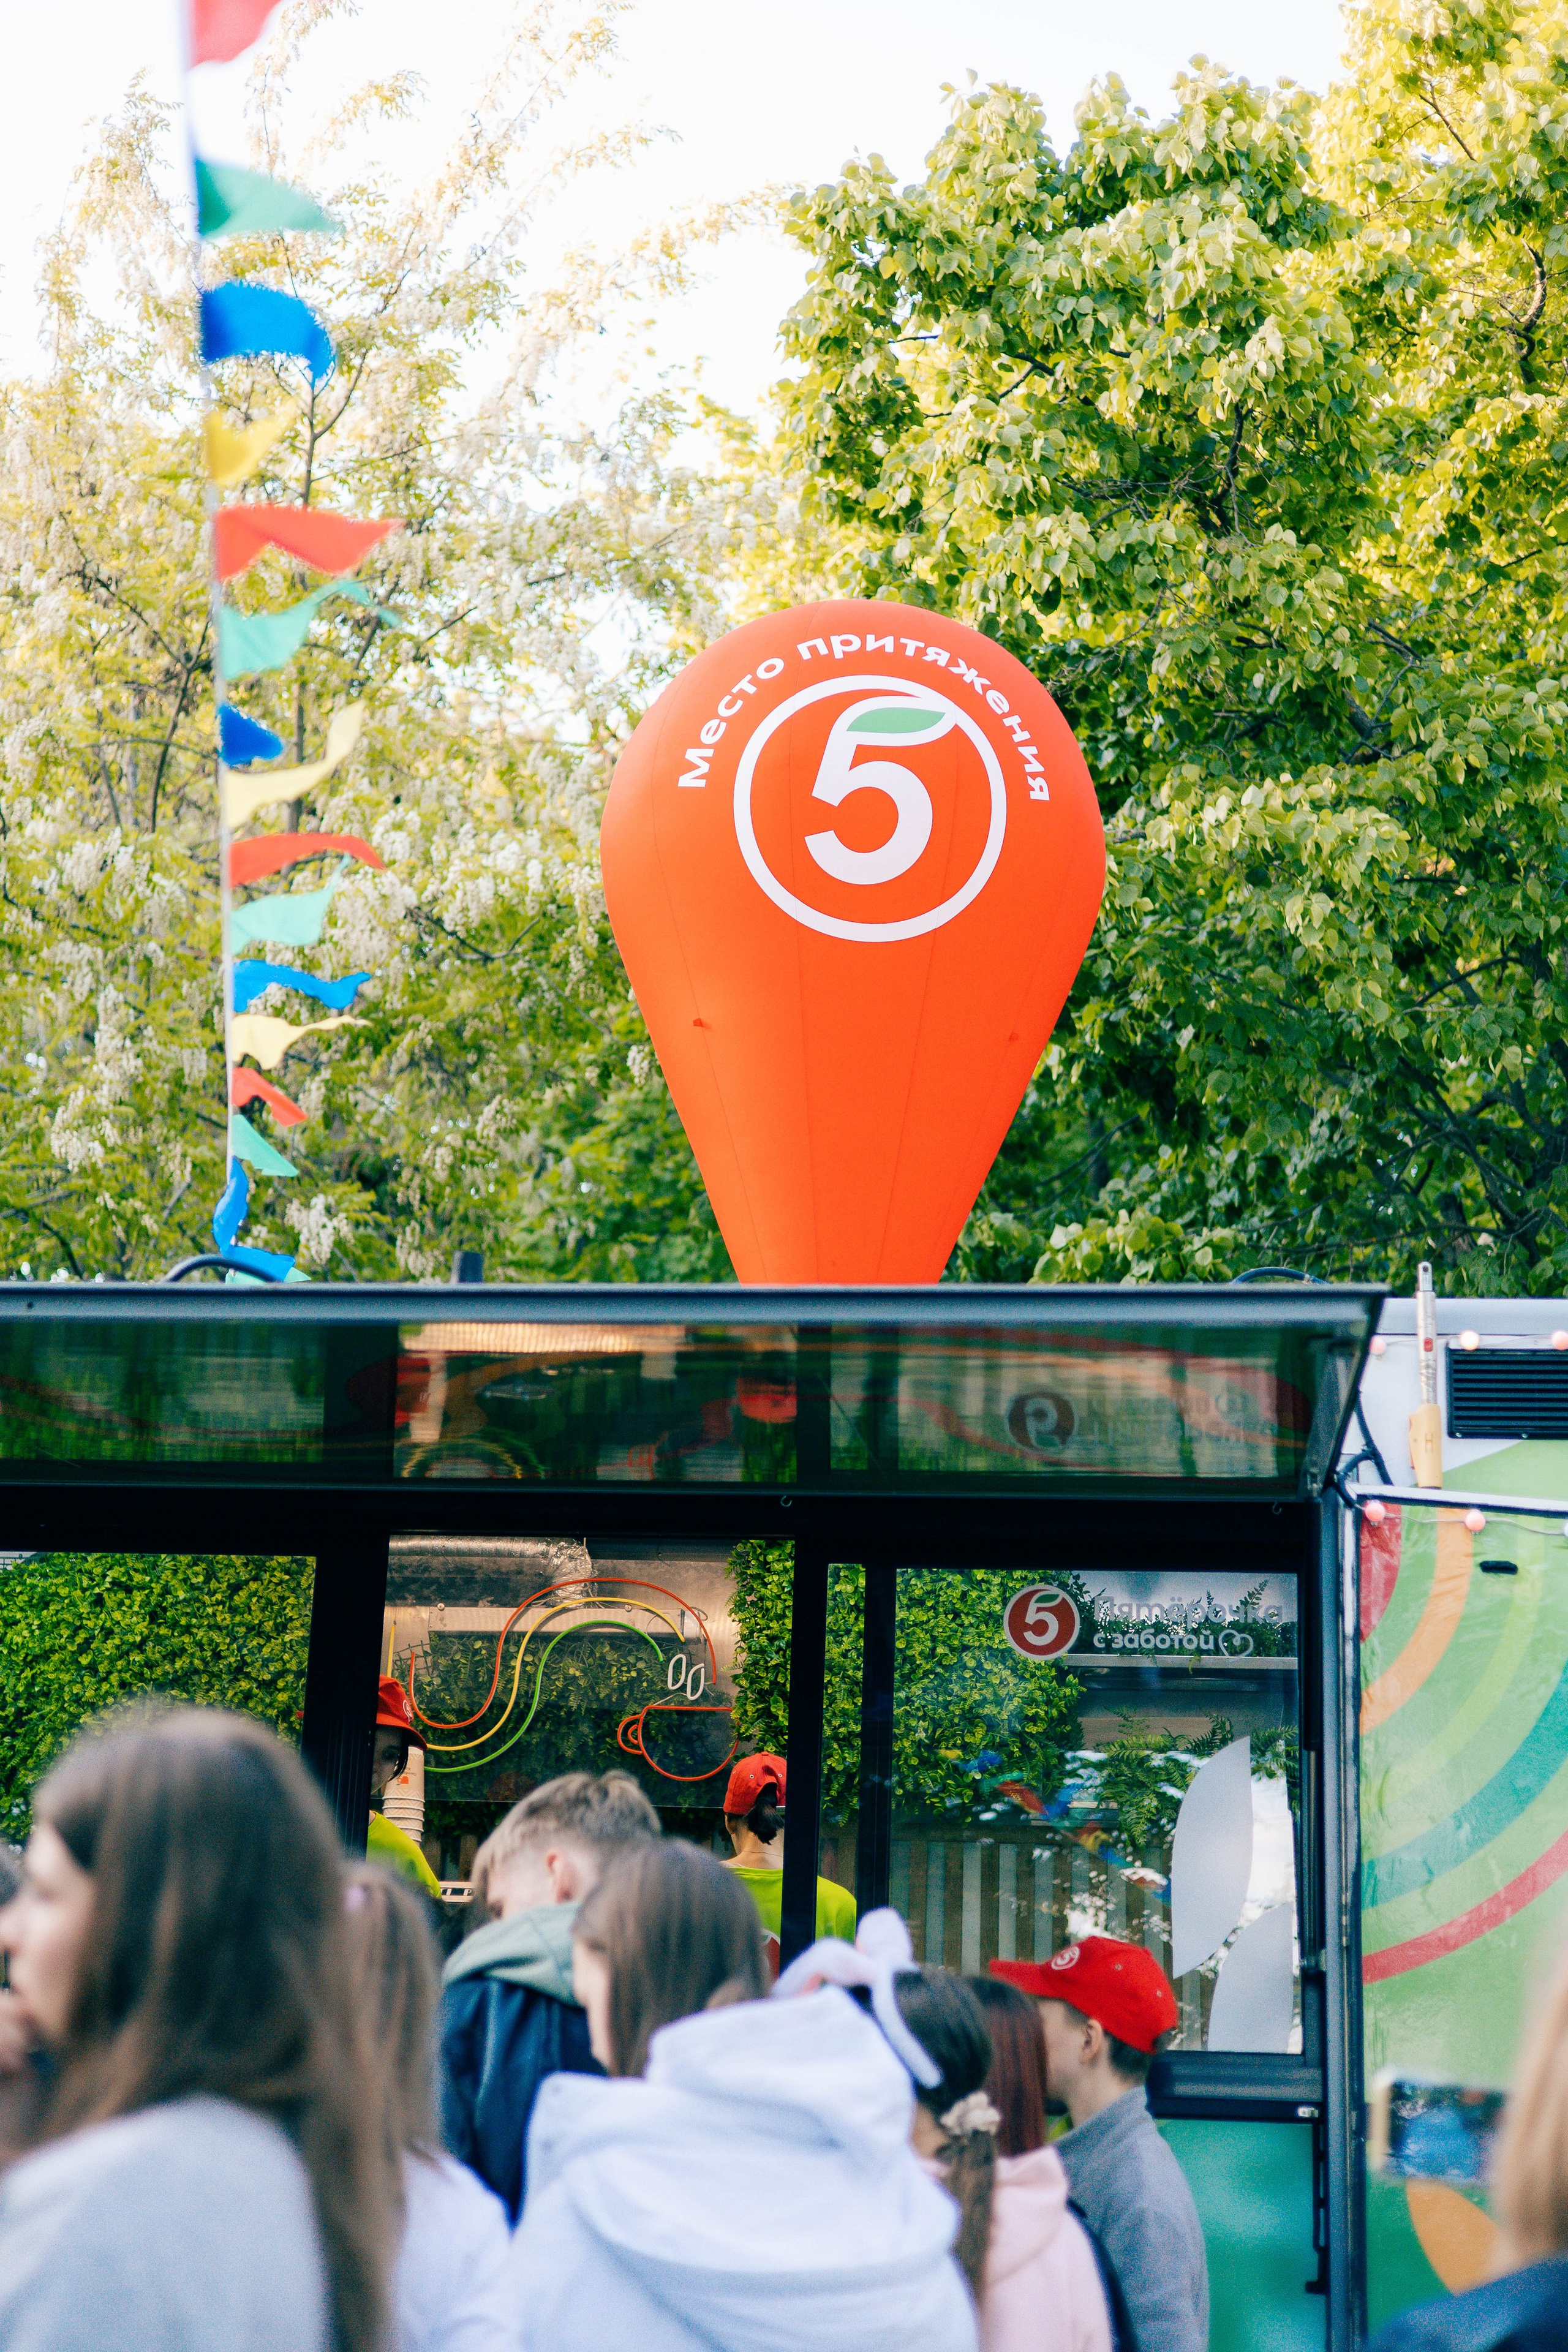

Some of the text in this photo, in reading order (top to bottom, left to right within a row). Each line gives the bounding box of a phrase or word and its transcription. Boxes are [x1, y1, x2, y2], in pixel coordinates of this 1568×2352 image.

[677, 633, 1050, 801] Место притяжения
[804, 695, 957, 886] 5
[1023, 1590, 1063, 1646] 5
[1093, 1628, 1215, 1650] с заботой
[1095, 1596, 1283, 1629] Пятёрочка
